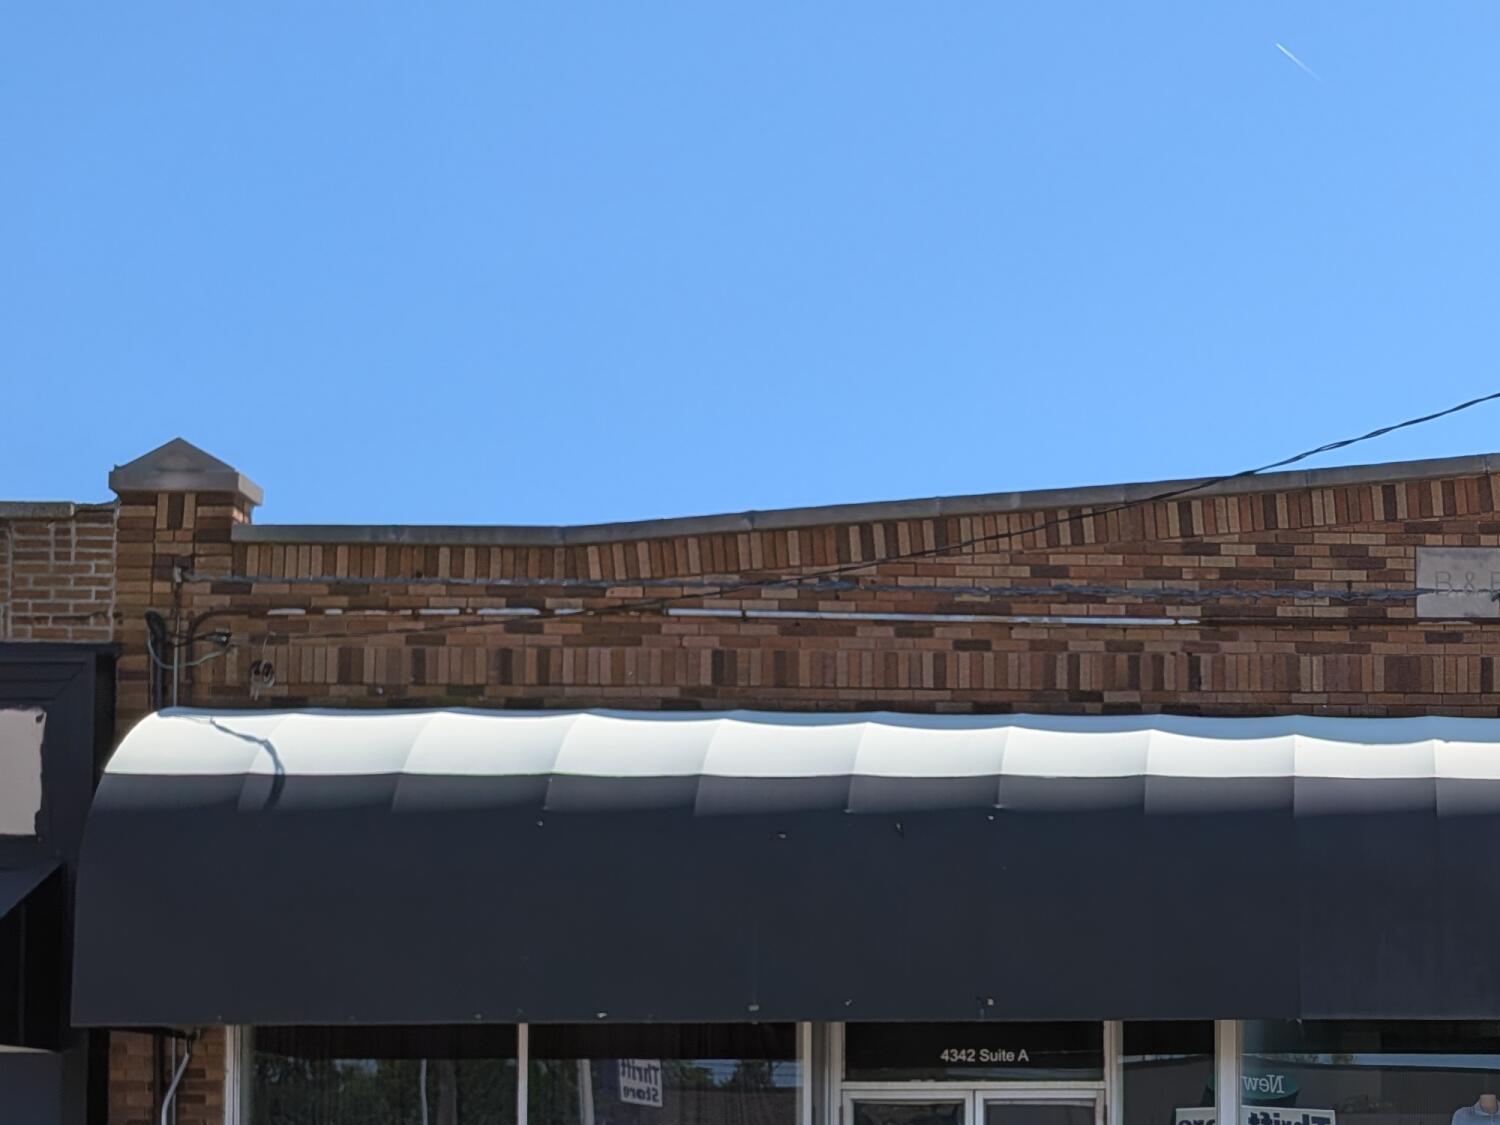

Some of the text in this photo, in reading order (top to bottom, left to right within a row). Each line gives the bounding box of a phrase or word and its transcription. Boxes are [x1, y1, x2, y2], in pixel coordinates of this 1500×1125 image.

[940, 1048, 1030, 1062] 4342 Suite A
